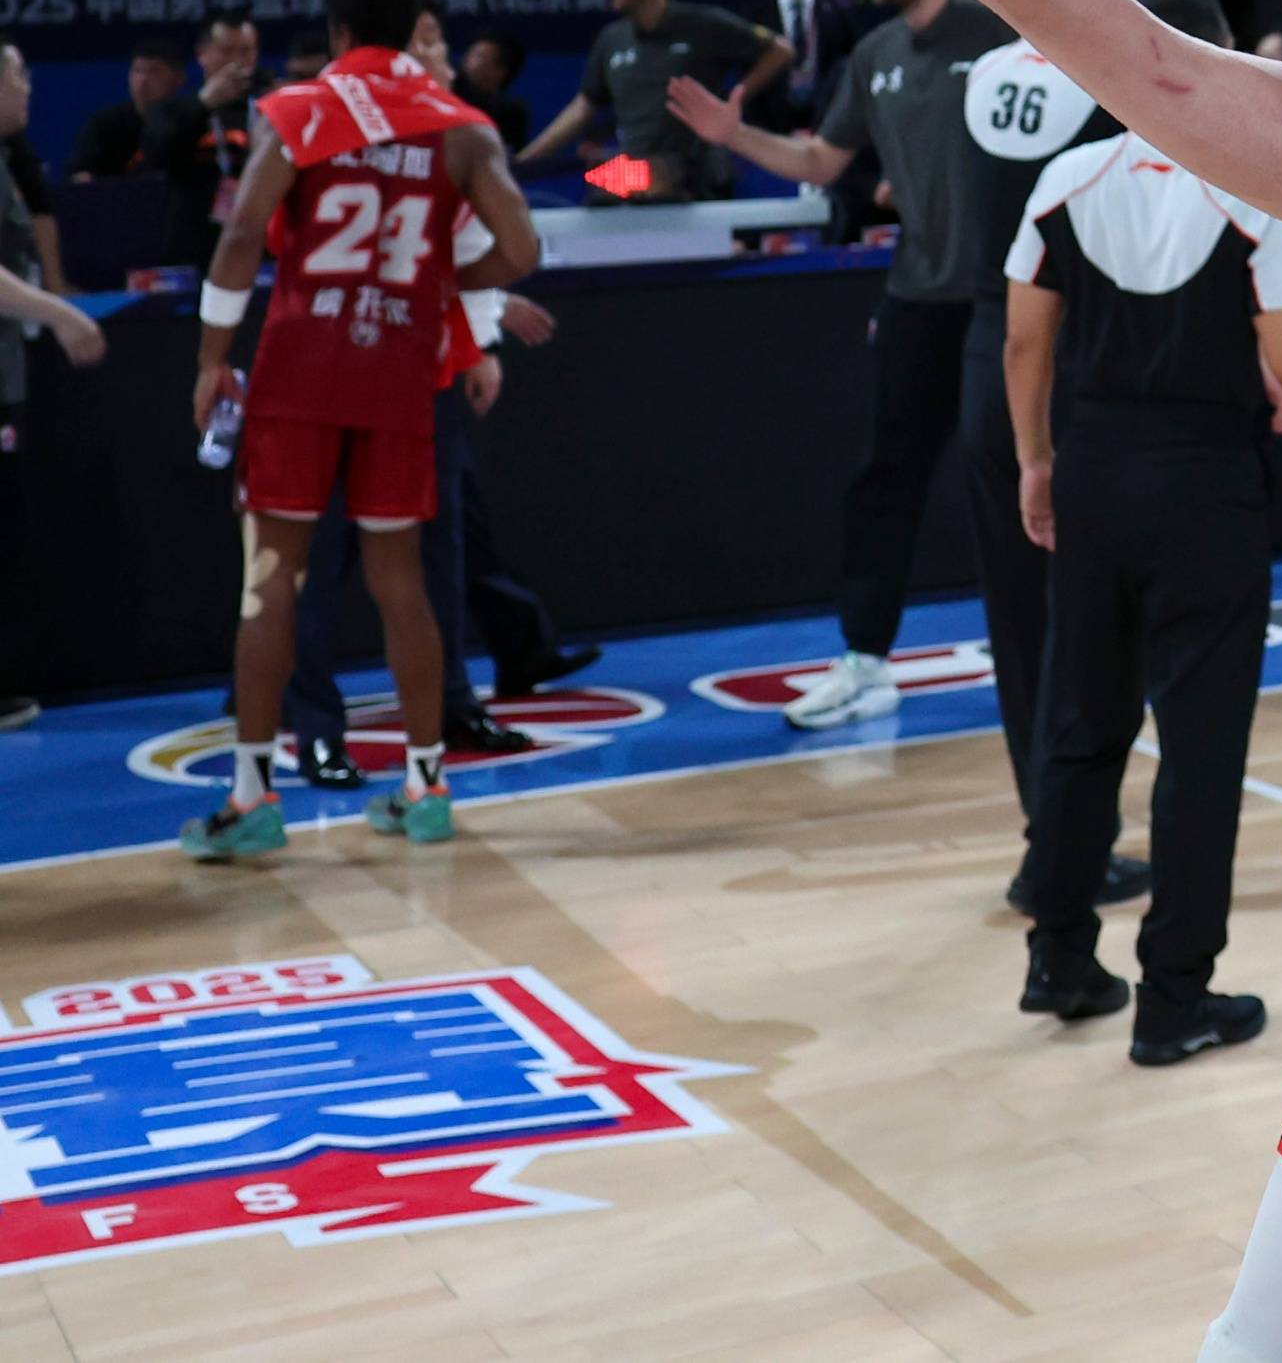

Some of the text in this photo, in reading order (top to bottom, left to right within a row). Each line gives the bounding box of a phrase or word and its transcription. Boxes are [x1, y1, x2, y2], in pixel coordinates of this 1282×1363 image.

[991, 82, 1048, 136] 36
[303, 183, 432, 286] 24
[50, 960, 346, 1017] 2025
